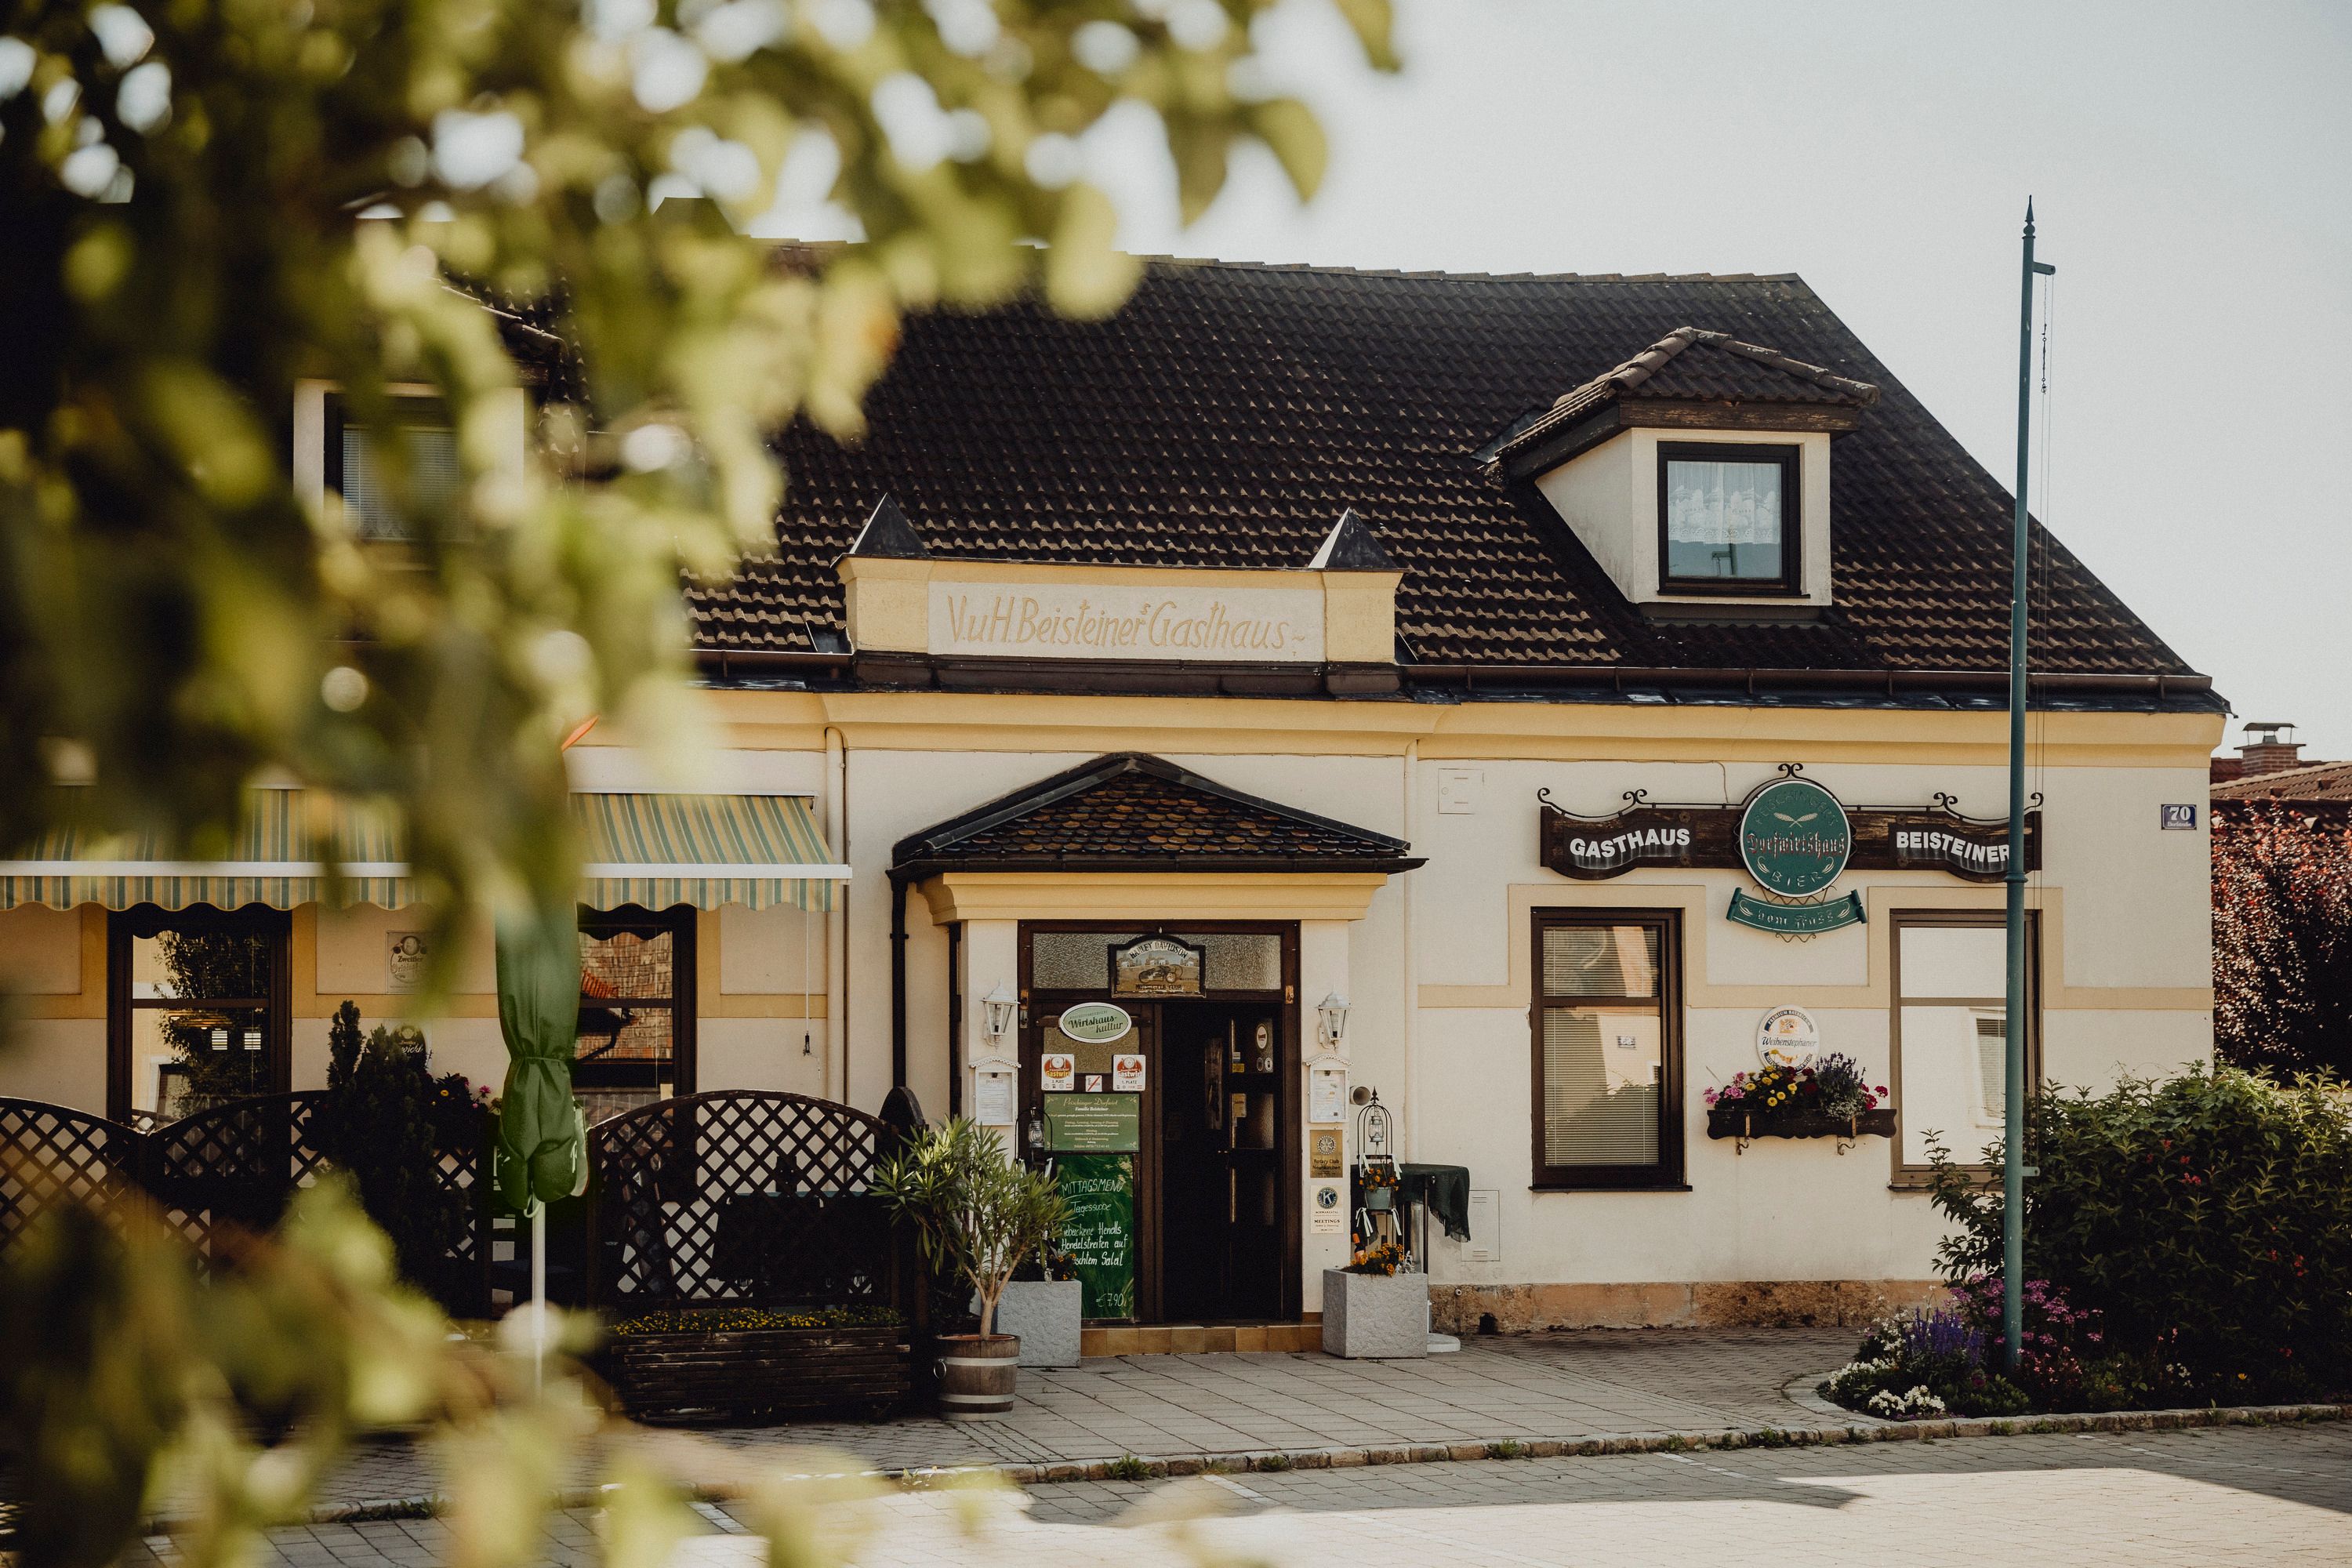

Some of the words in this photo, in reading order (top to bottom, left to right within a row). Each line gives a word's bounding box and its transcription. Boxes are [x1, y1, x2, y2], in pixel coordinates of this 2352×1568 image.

[1148, 601, 1290, 650] Gasthaus
[2169, 806, 2191, 821] 70
[1570, 829, 1690, 858] GASTHAUS
[1747, 831, 1845, 860] Dorfwirtshaus
[1896, 831, 2009, 863] BEISTEINER
[1771, 870, 1823, 887] BIER
[1758, 909, 1788, 925] vom
[1129, 942, 1153, 960] HARLEY
[1155, 941, 1189, 959] DAVIDSON
[1068, 1015, 1117, 1029] Wirtshaus-
[1096, 1022, 1123, 1033] kultur
[1762, 1036, 1817, 1048] Weihenstephaner
[1070, 1200, 1112, 1216] Tagessuppe
[1063, 1223, 1094, 1236] ebackene
[1062, 1235, 1109, 1250] Hendelstreifen
[1114, 1234, 1128, 1248] auf
[1101, 1250, 1124, 1266] Salat
